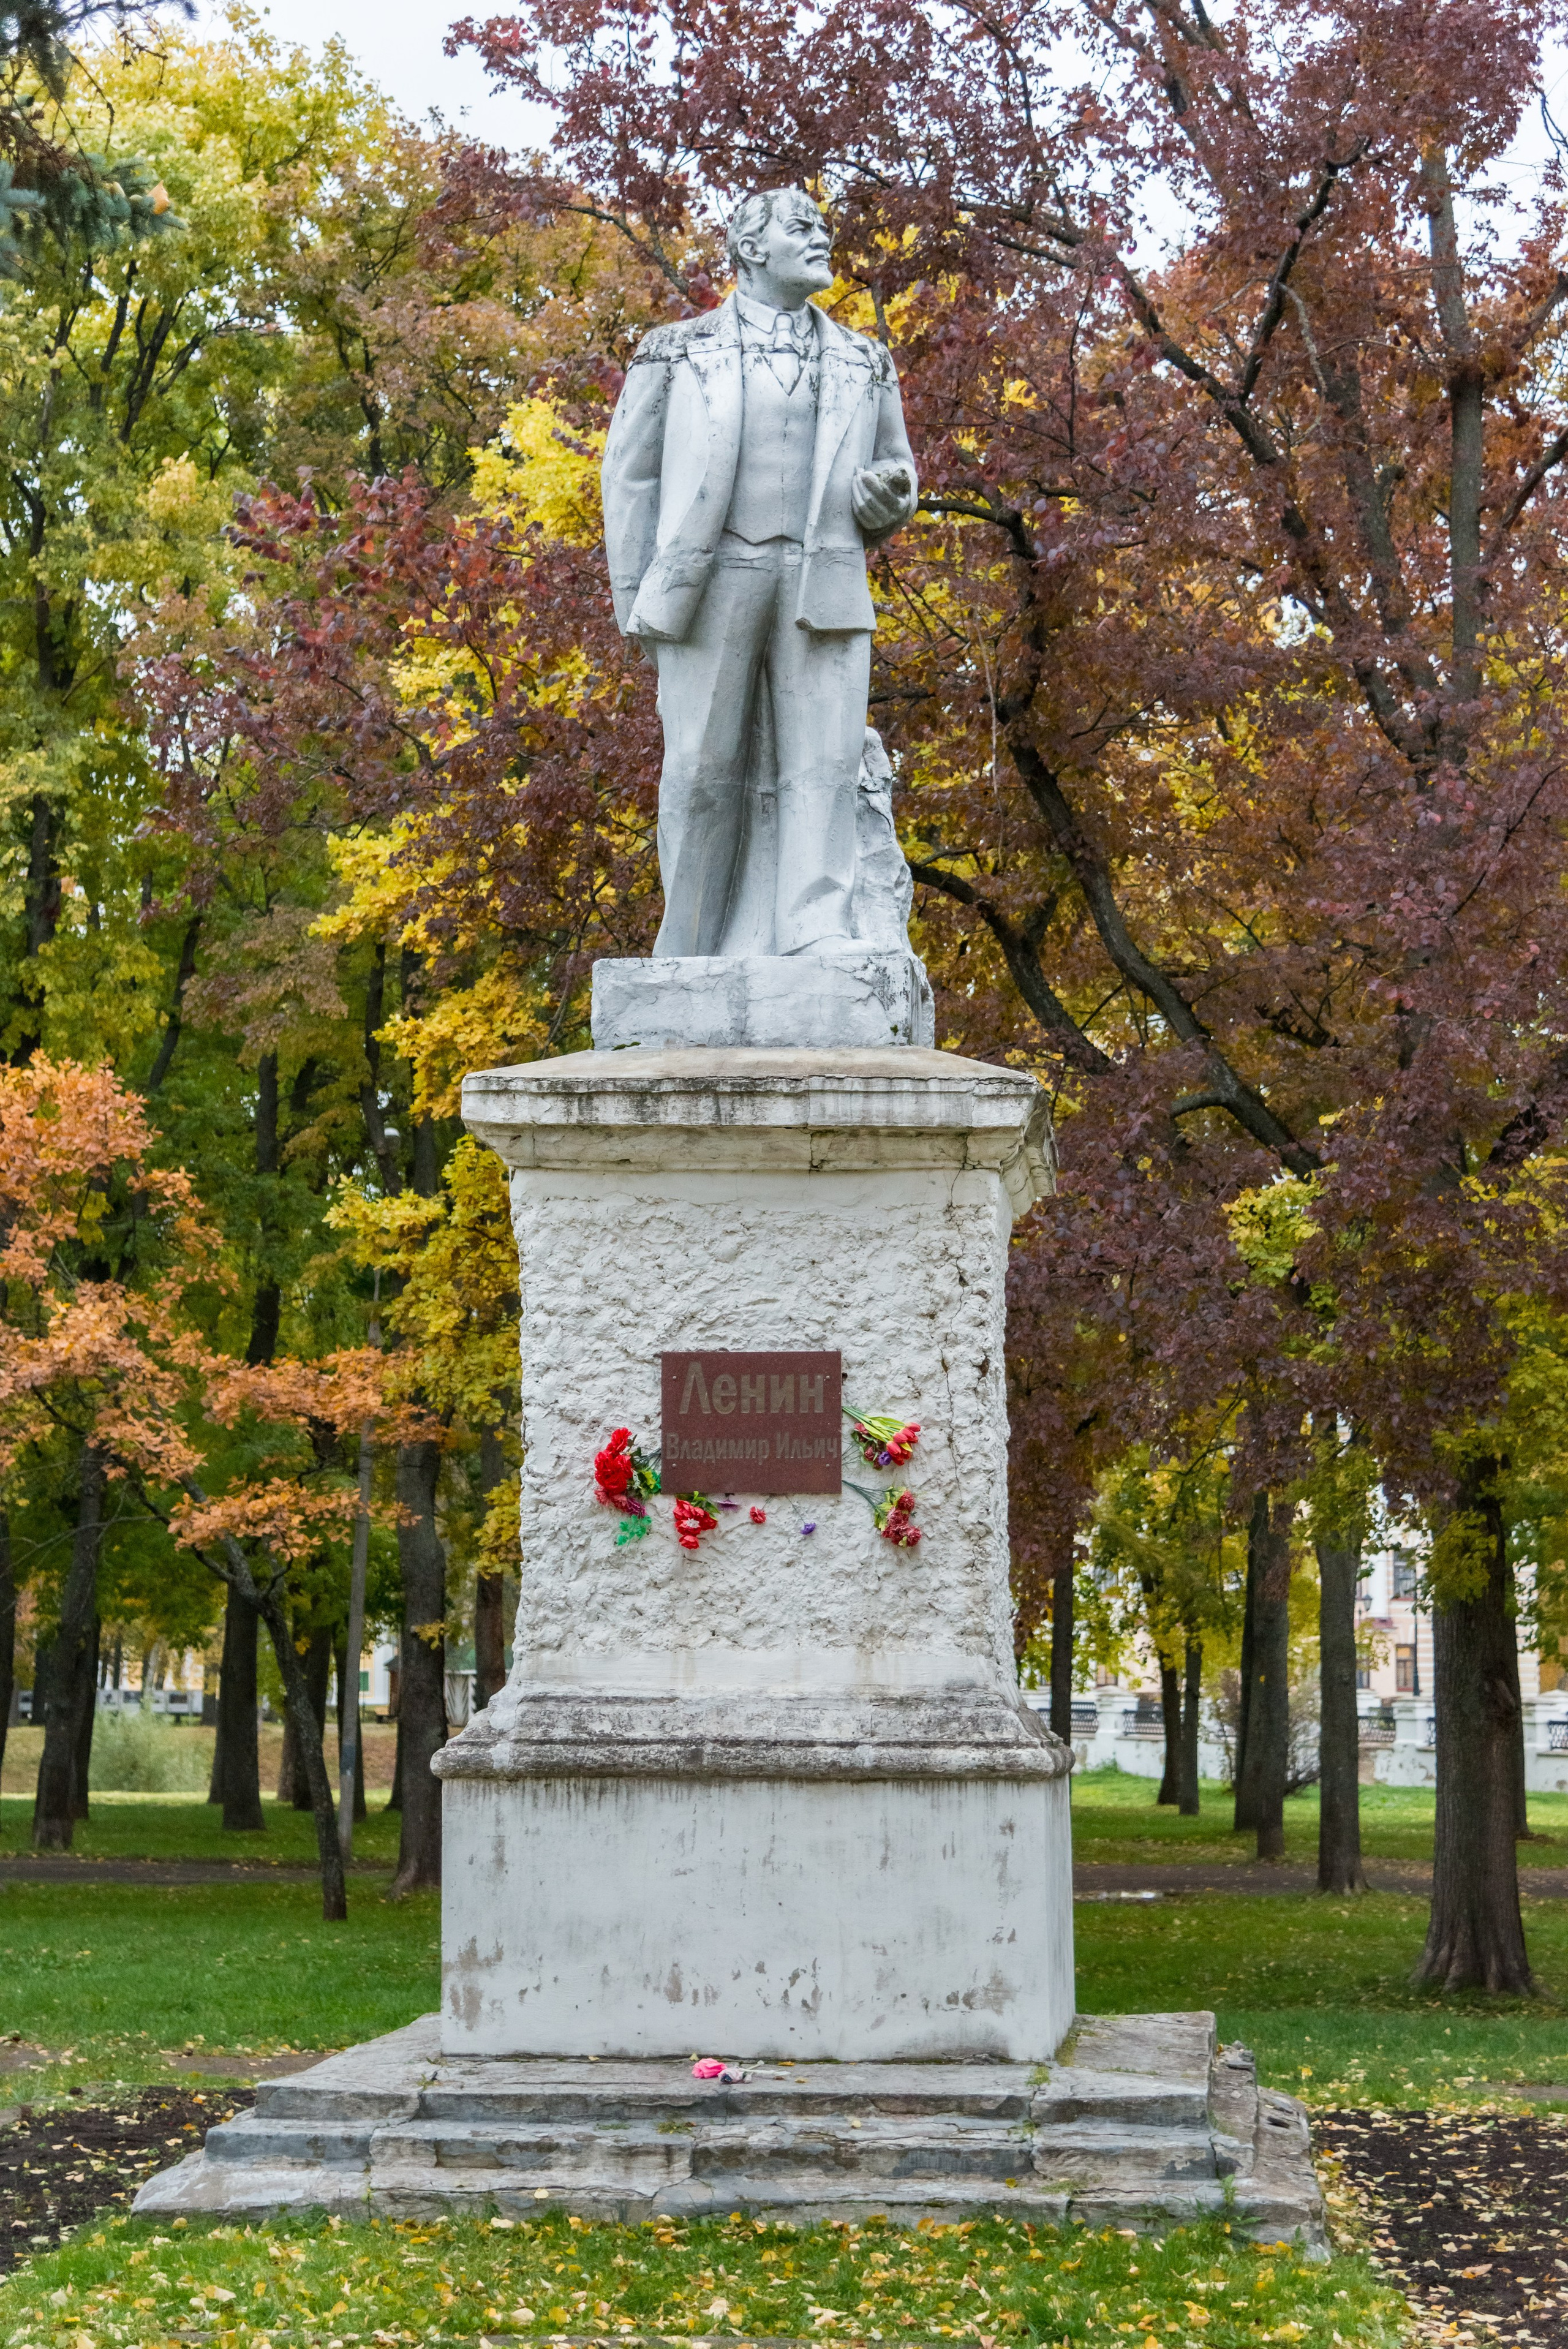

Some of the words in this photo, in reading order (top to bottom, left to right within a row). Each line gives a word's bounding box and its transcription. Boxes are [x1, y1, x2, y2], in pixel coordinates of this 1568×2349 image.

[679, 1361, 824, 1414] Ленин
[666, 1432, 769, 1465] Владимир
[775, 1431, 838, 1459] Ильич
